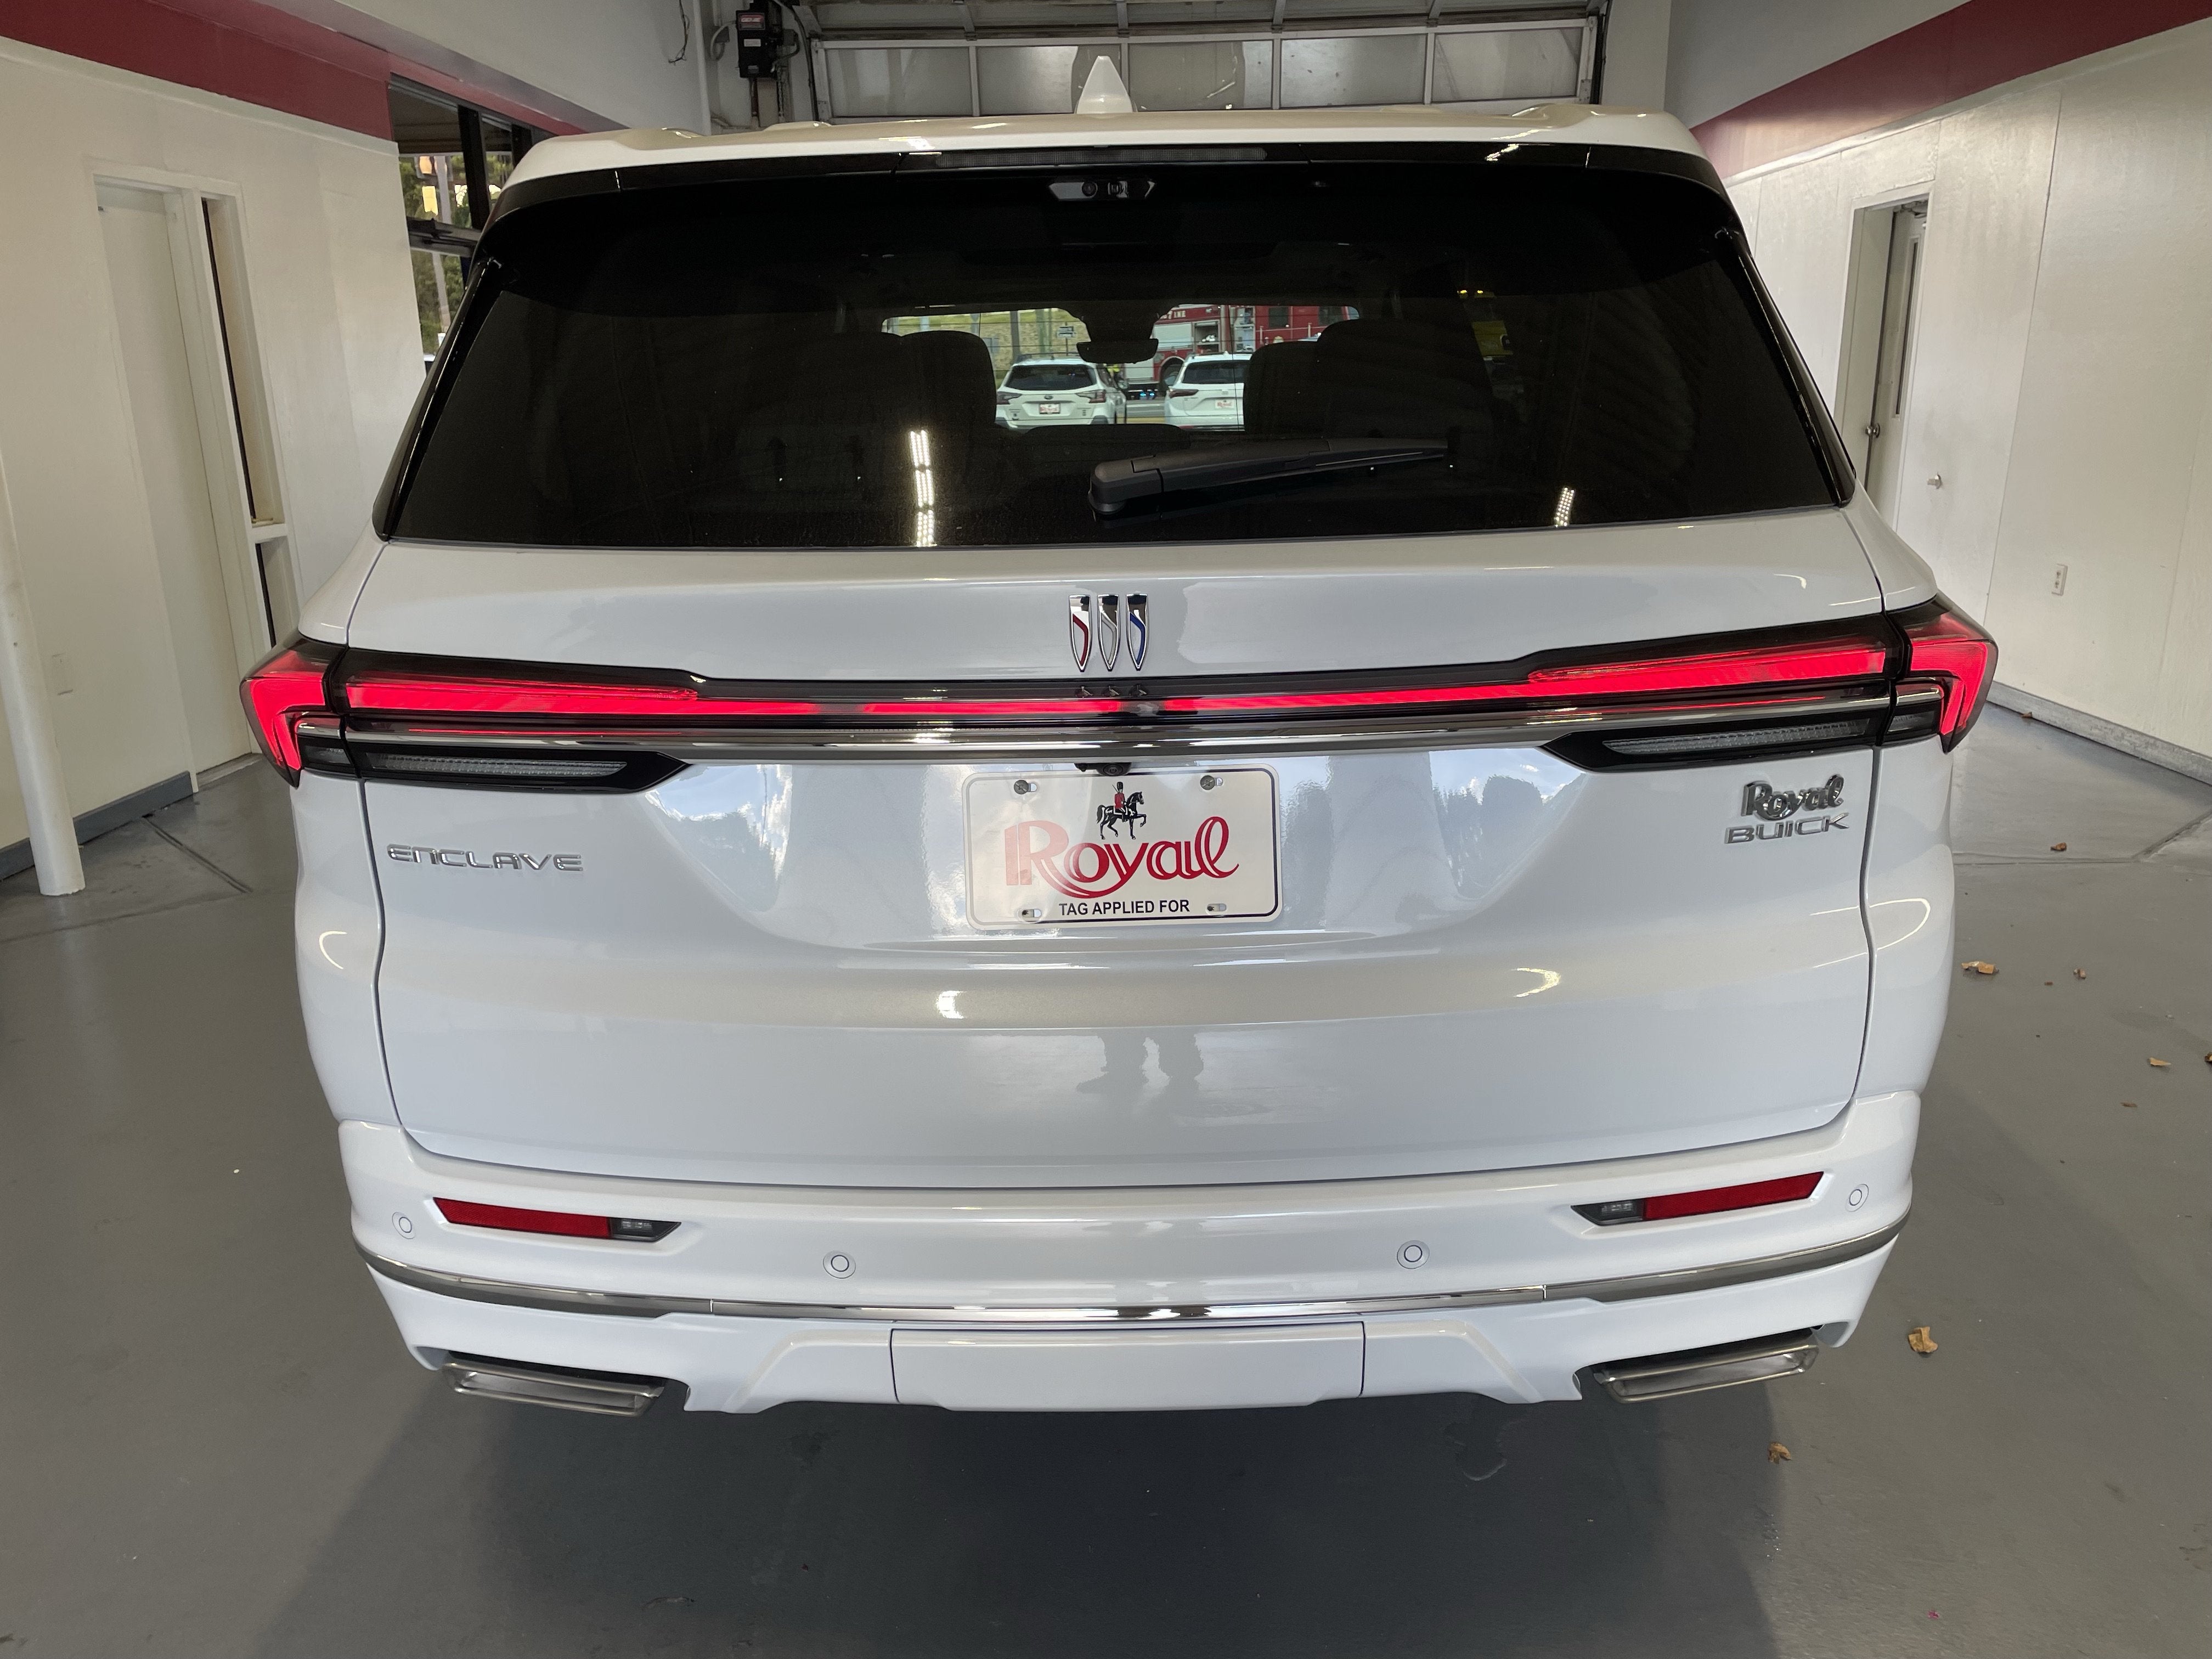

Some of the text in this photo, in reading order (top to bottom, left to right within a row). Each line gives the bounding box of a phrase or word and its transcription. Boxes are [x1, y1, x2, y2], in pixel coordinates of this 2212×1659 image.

[1741, 774, 1844, 821] Royal
[1725, 812, 1849, 844] BUICK
[387, 844, 583, 871] ENCLAVE
[1005, 816, 1239, 899] Royal
[1058, 899, 1190, 916] TAG APPLIED FOR
